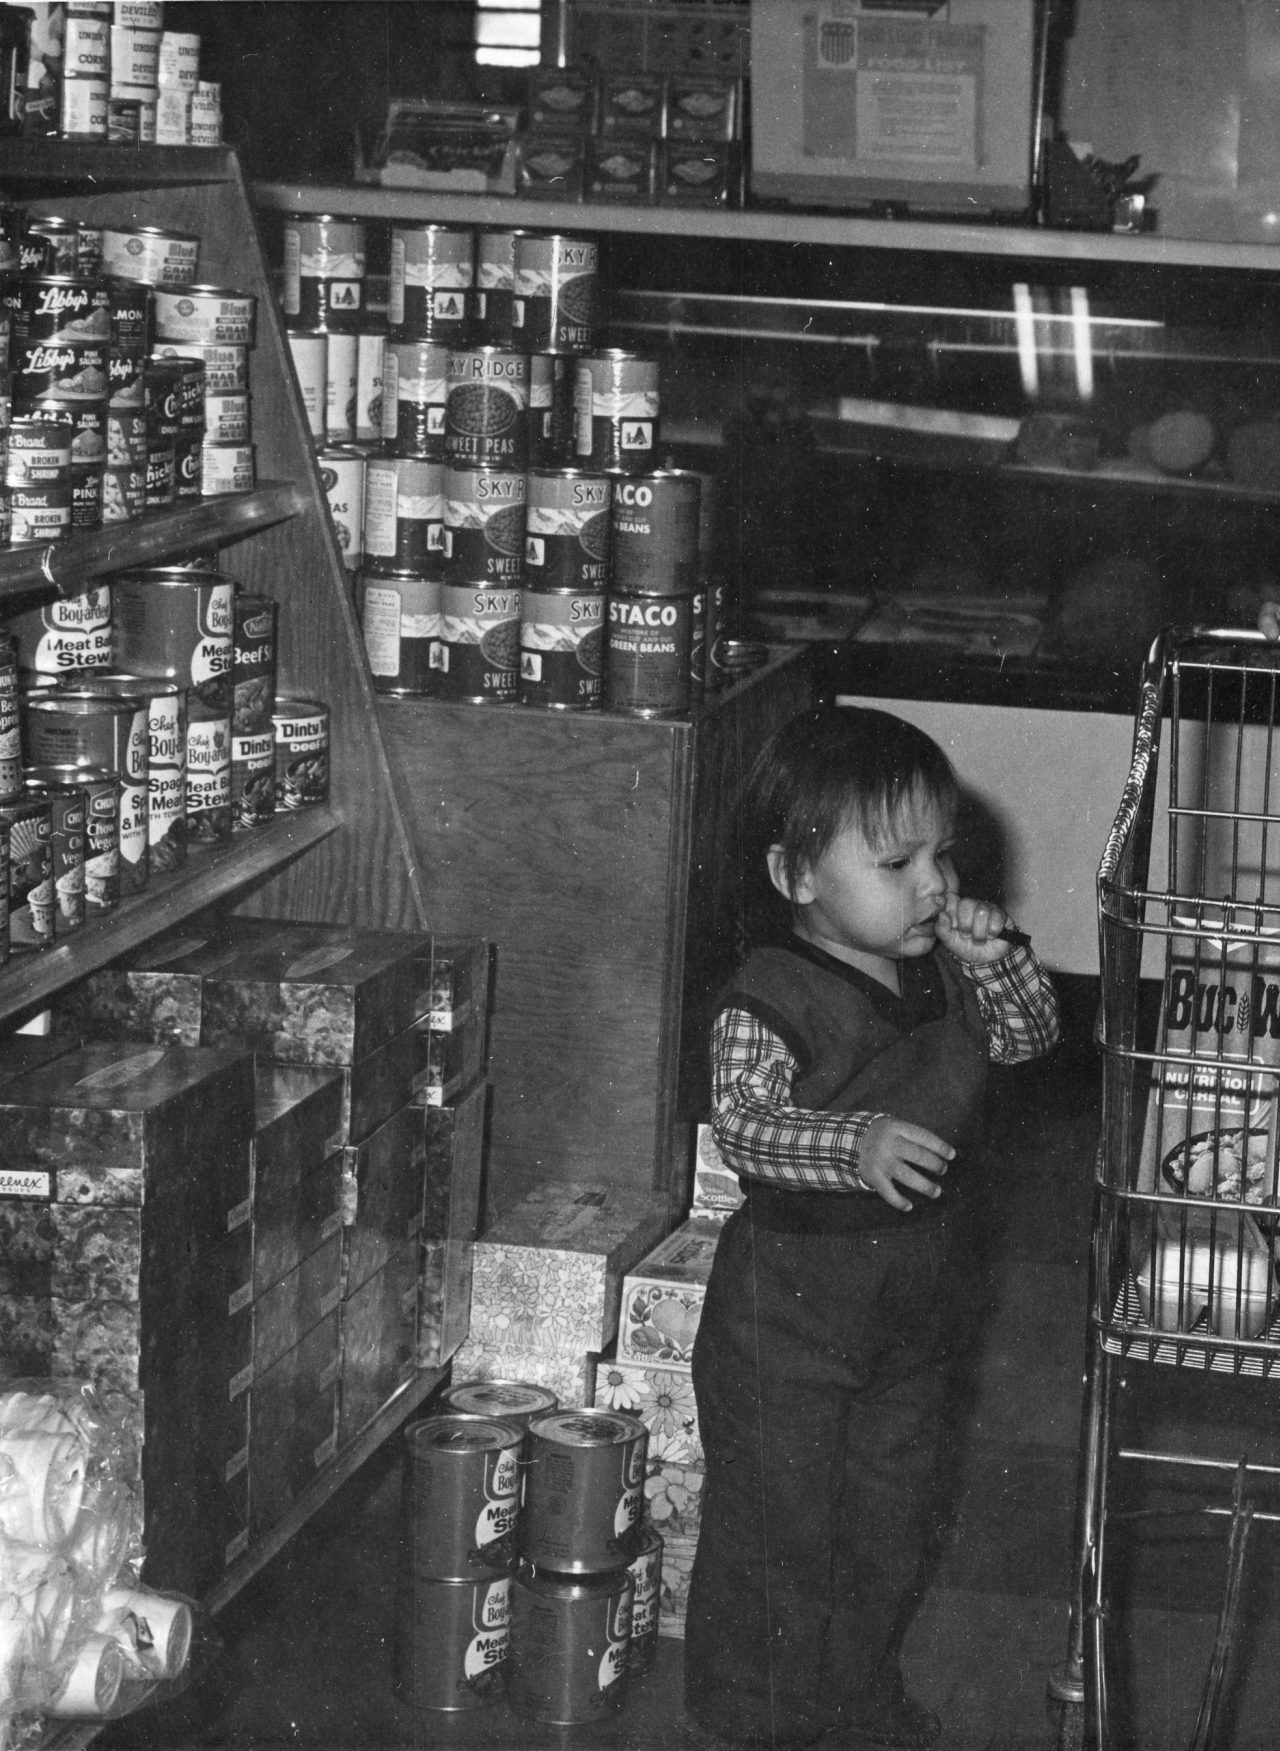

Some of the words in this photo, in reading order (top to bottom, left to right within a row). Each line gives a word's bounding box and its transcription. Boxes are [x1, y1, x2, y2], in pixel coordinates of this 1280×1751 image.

[472, 357, 525, 378] RIDGE
[486, 437, 515, 454] PEAS
[31, 456, 59, 465] BROKEN
[31, 469, 59, 480] SHRIMP
[34, 515, 62, 523] BROKEN
[34, 528, 61, 538] SHRIMP
[619, 522, 650, 534] BEANS
[610, 601, 677, 626] STACO
[610, 639, 637, 652] GREEN
[640, 642, 675, 653] BEANS
[56, 652, 109, 667] Stew
[281, 719, 319, 738] Dinty
[700, 1193, 738, 1203] Scotties
